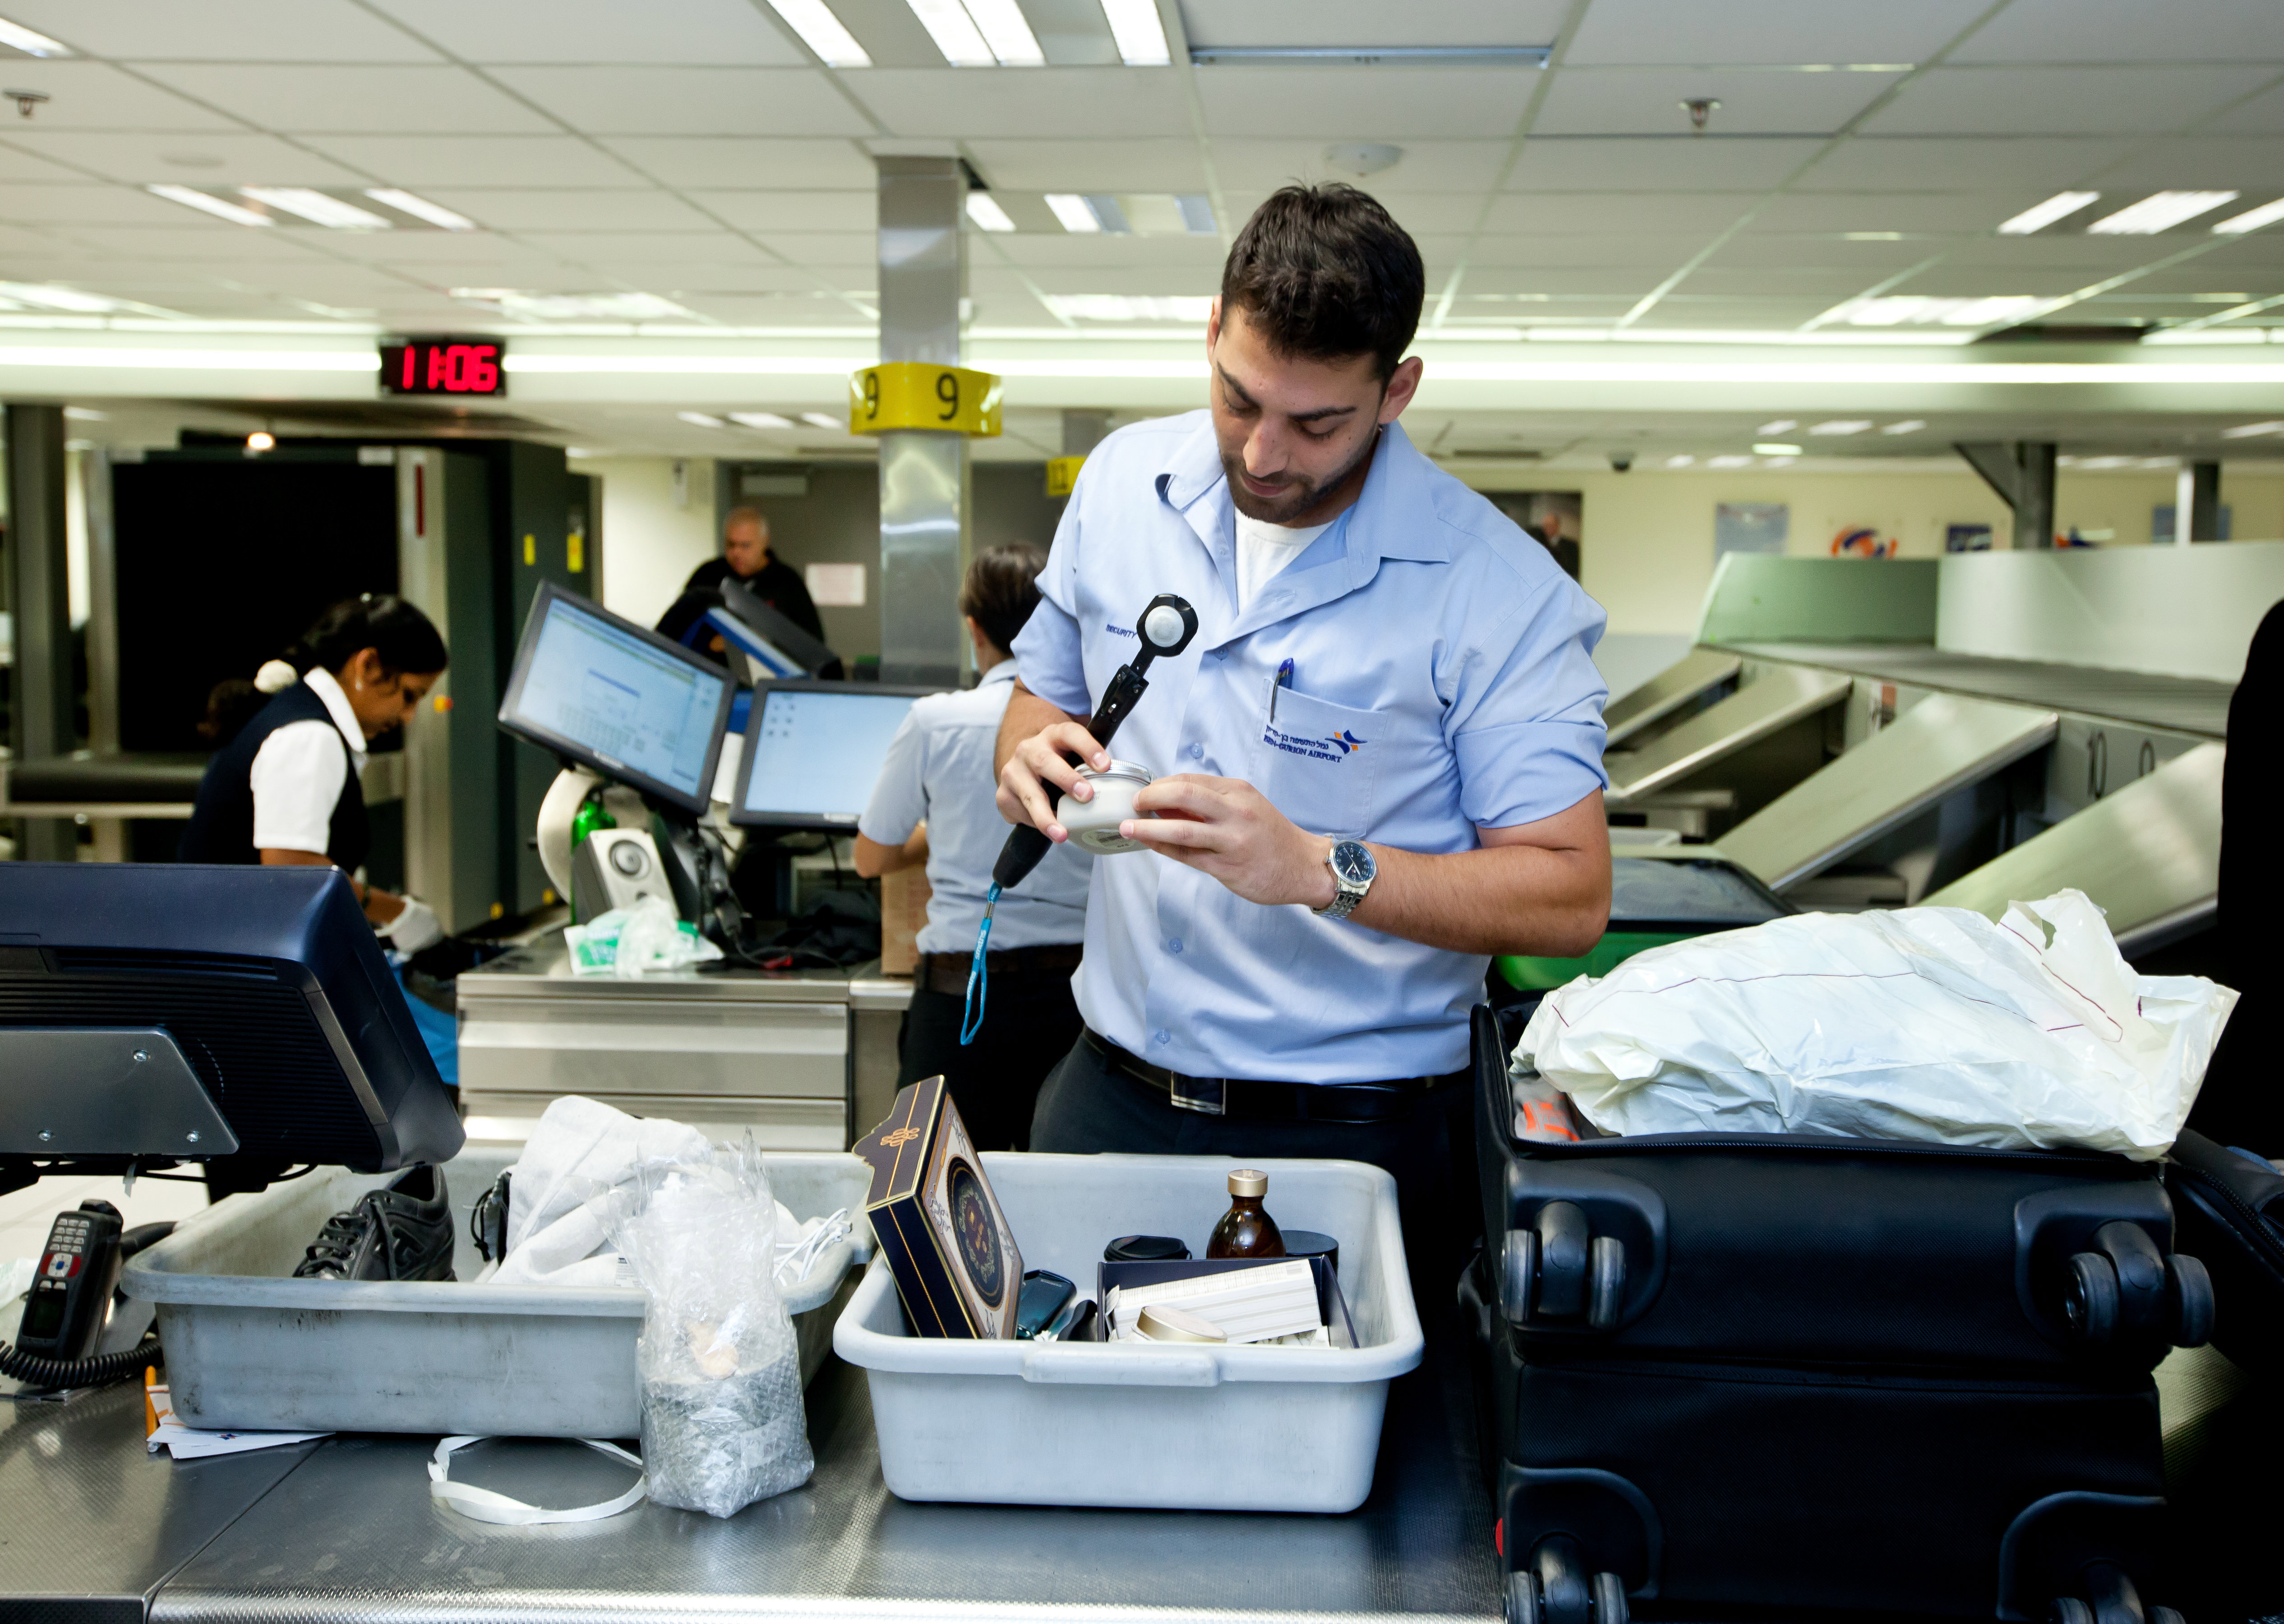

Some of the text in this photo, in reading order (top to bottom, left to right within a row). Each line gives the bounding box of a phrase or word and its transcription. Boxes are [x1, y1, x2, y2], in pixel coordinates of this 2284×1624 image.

[403, 345, 498, 391] 11:06
[936, 372, 959, 422] 9
[1106, 624, 1137, 639] SECURITY
[1264, 734, 1342, 763] BEN-GURION AIRPORT
[2087, 729, 2107, 802] 10
